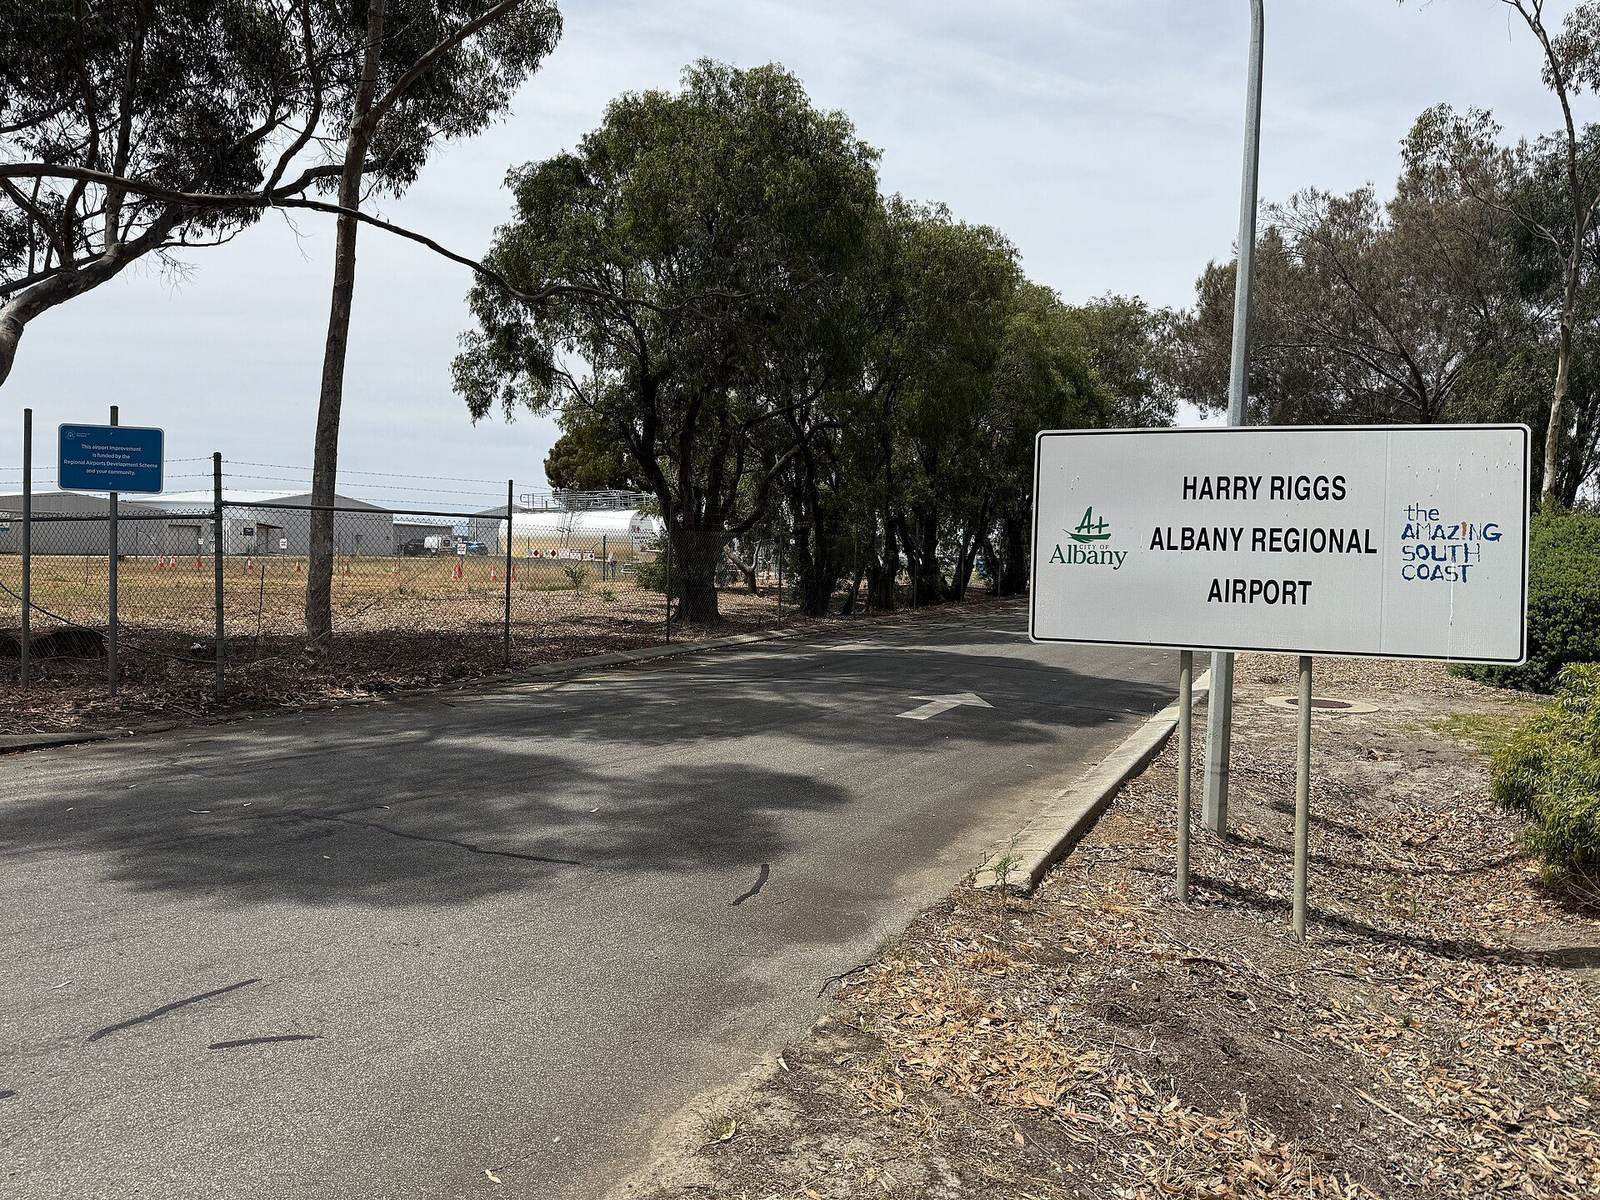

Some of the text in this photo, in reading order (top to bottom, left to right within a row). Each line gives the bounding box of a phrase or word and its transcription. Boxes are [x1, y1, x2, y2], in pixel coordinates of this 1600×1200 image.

[1182, 475, 1347, 501] HARRY RIGGS
[1403, 502, 1440, 522] the
[1149, 526, 1378, 554] ALBANY REGIONAL
[1401, 542, 1481, 563] SOUTH
[1048, 543, 1129, 571] Albany
[1401, 563, 1474, 583] COAST
[1206, 579, 1313, 606] AIRPORT
